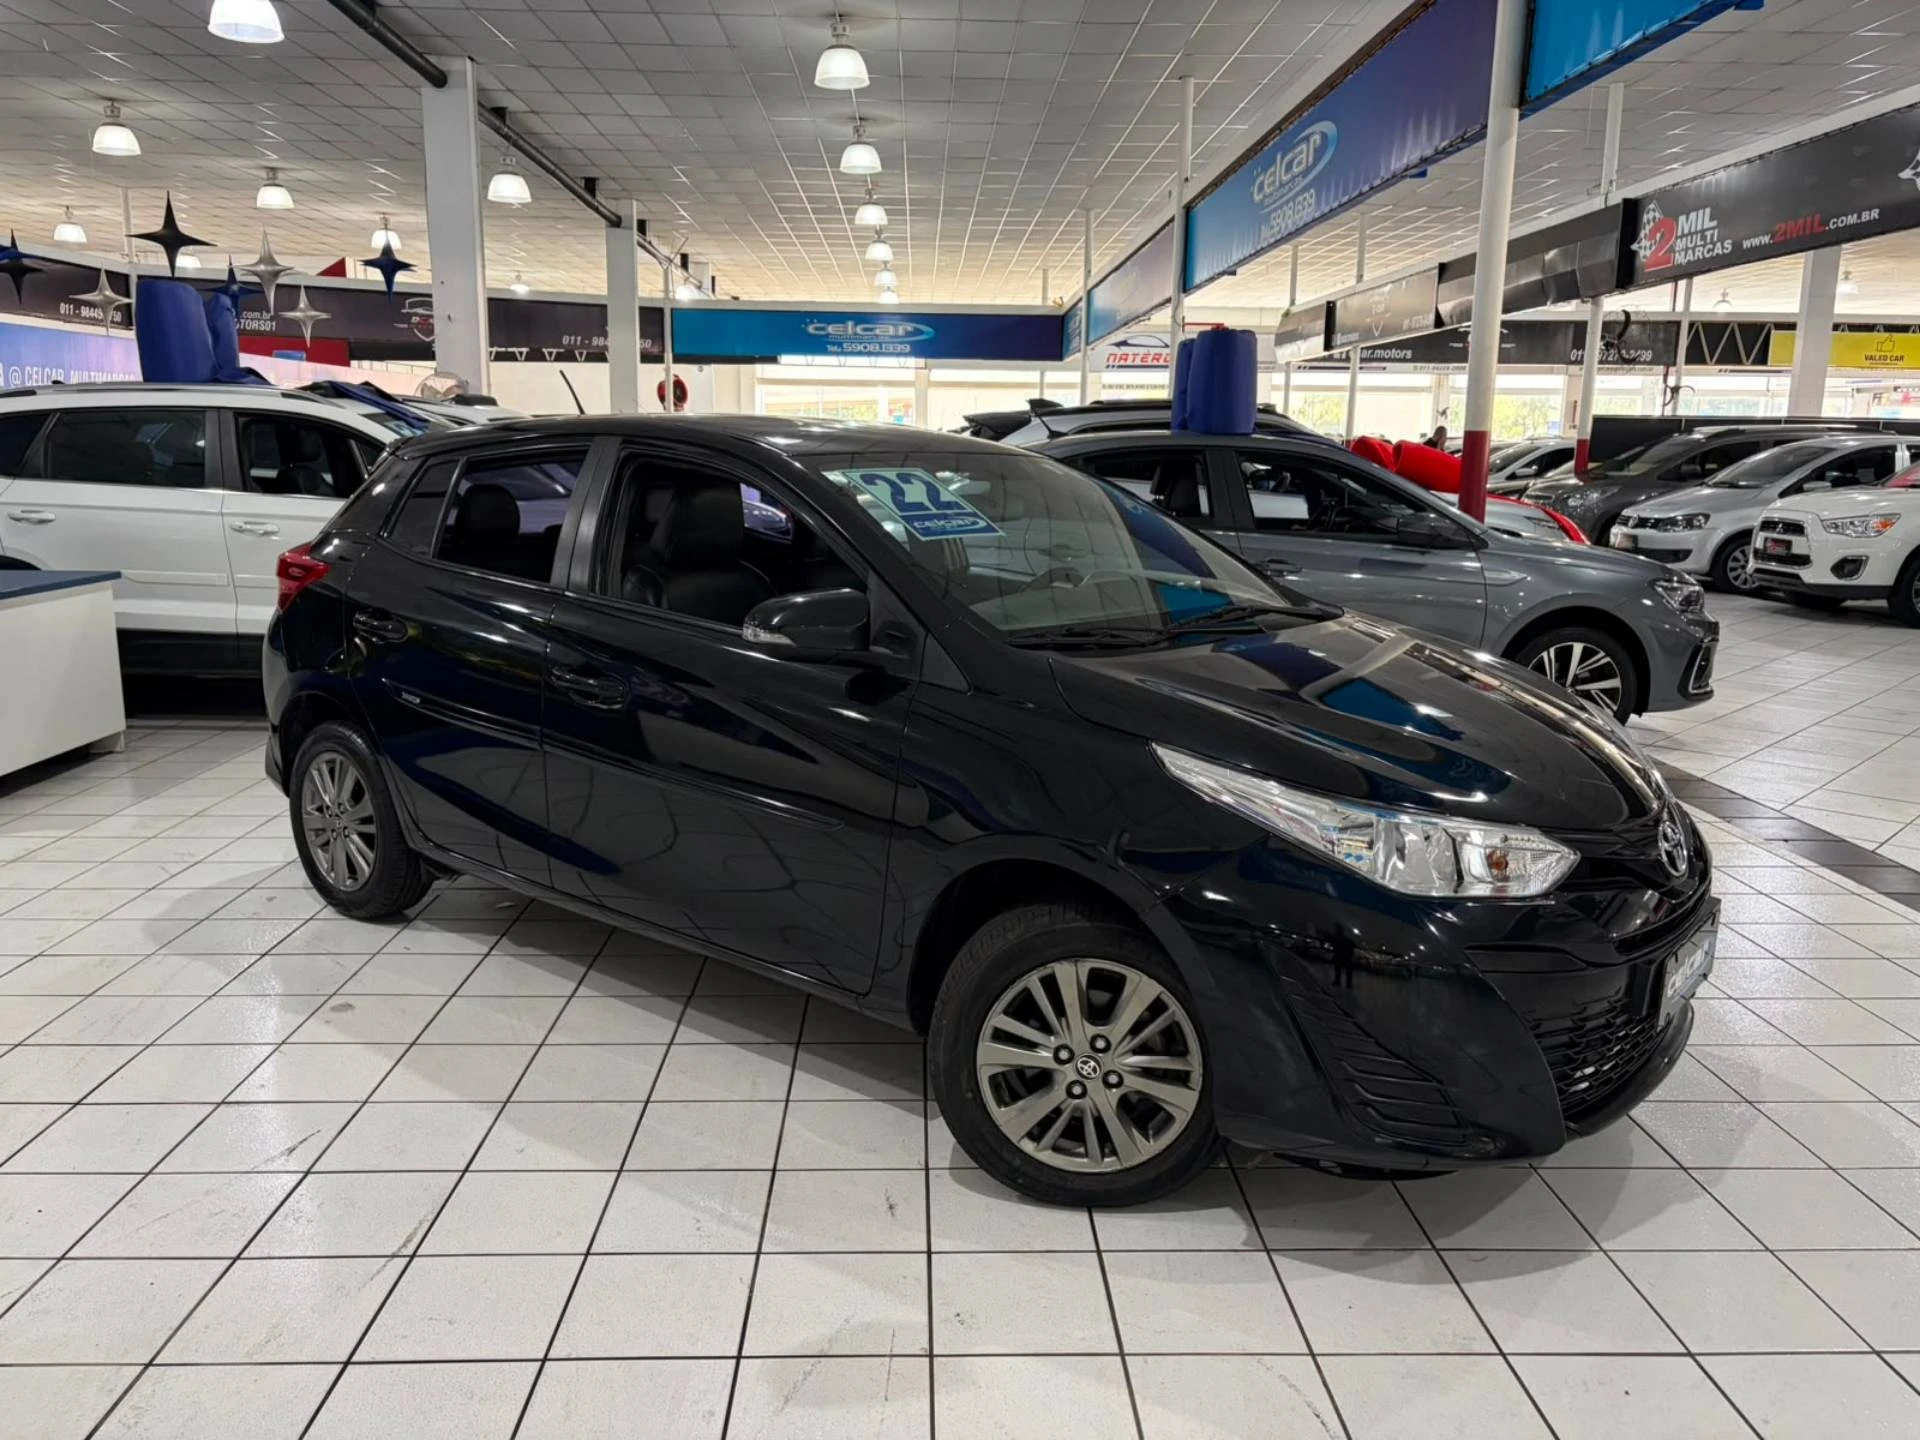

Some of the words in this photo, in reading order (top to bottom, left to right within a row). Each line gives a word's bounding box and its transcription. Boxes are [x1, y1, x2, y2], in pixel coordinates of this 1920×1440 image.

[1254, 131, 1322, 204] celcar
[1644, 216, 1677, 272] 2
[1677, 207, 1718, 237] MIL
[1674, 239, 1733, 266] MARCAS
[1676, 228, 1719, 252] MULTI
[562, 335, 581, 346] 011
[806, 320, 914, 336] celcar
[859, 473, 967, 514] 22
